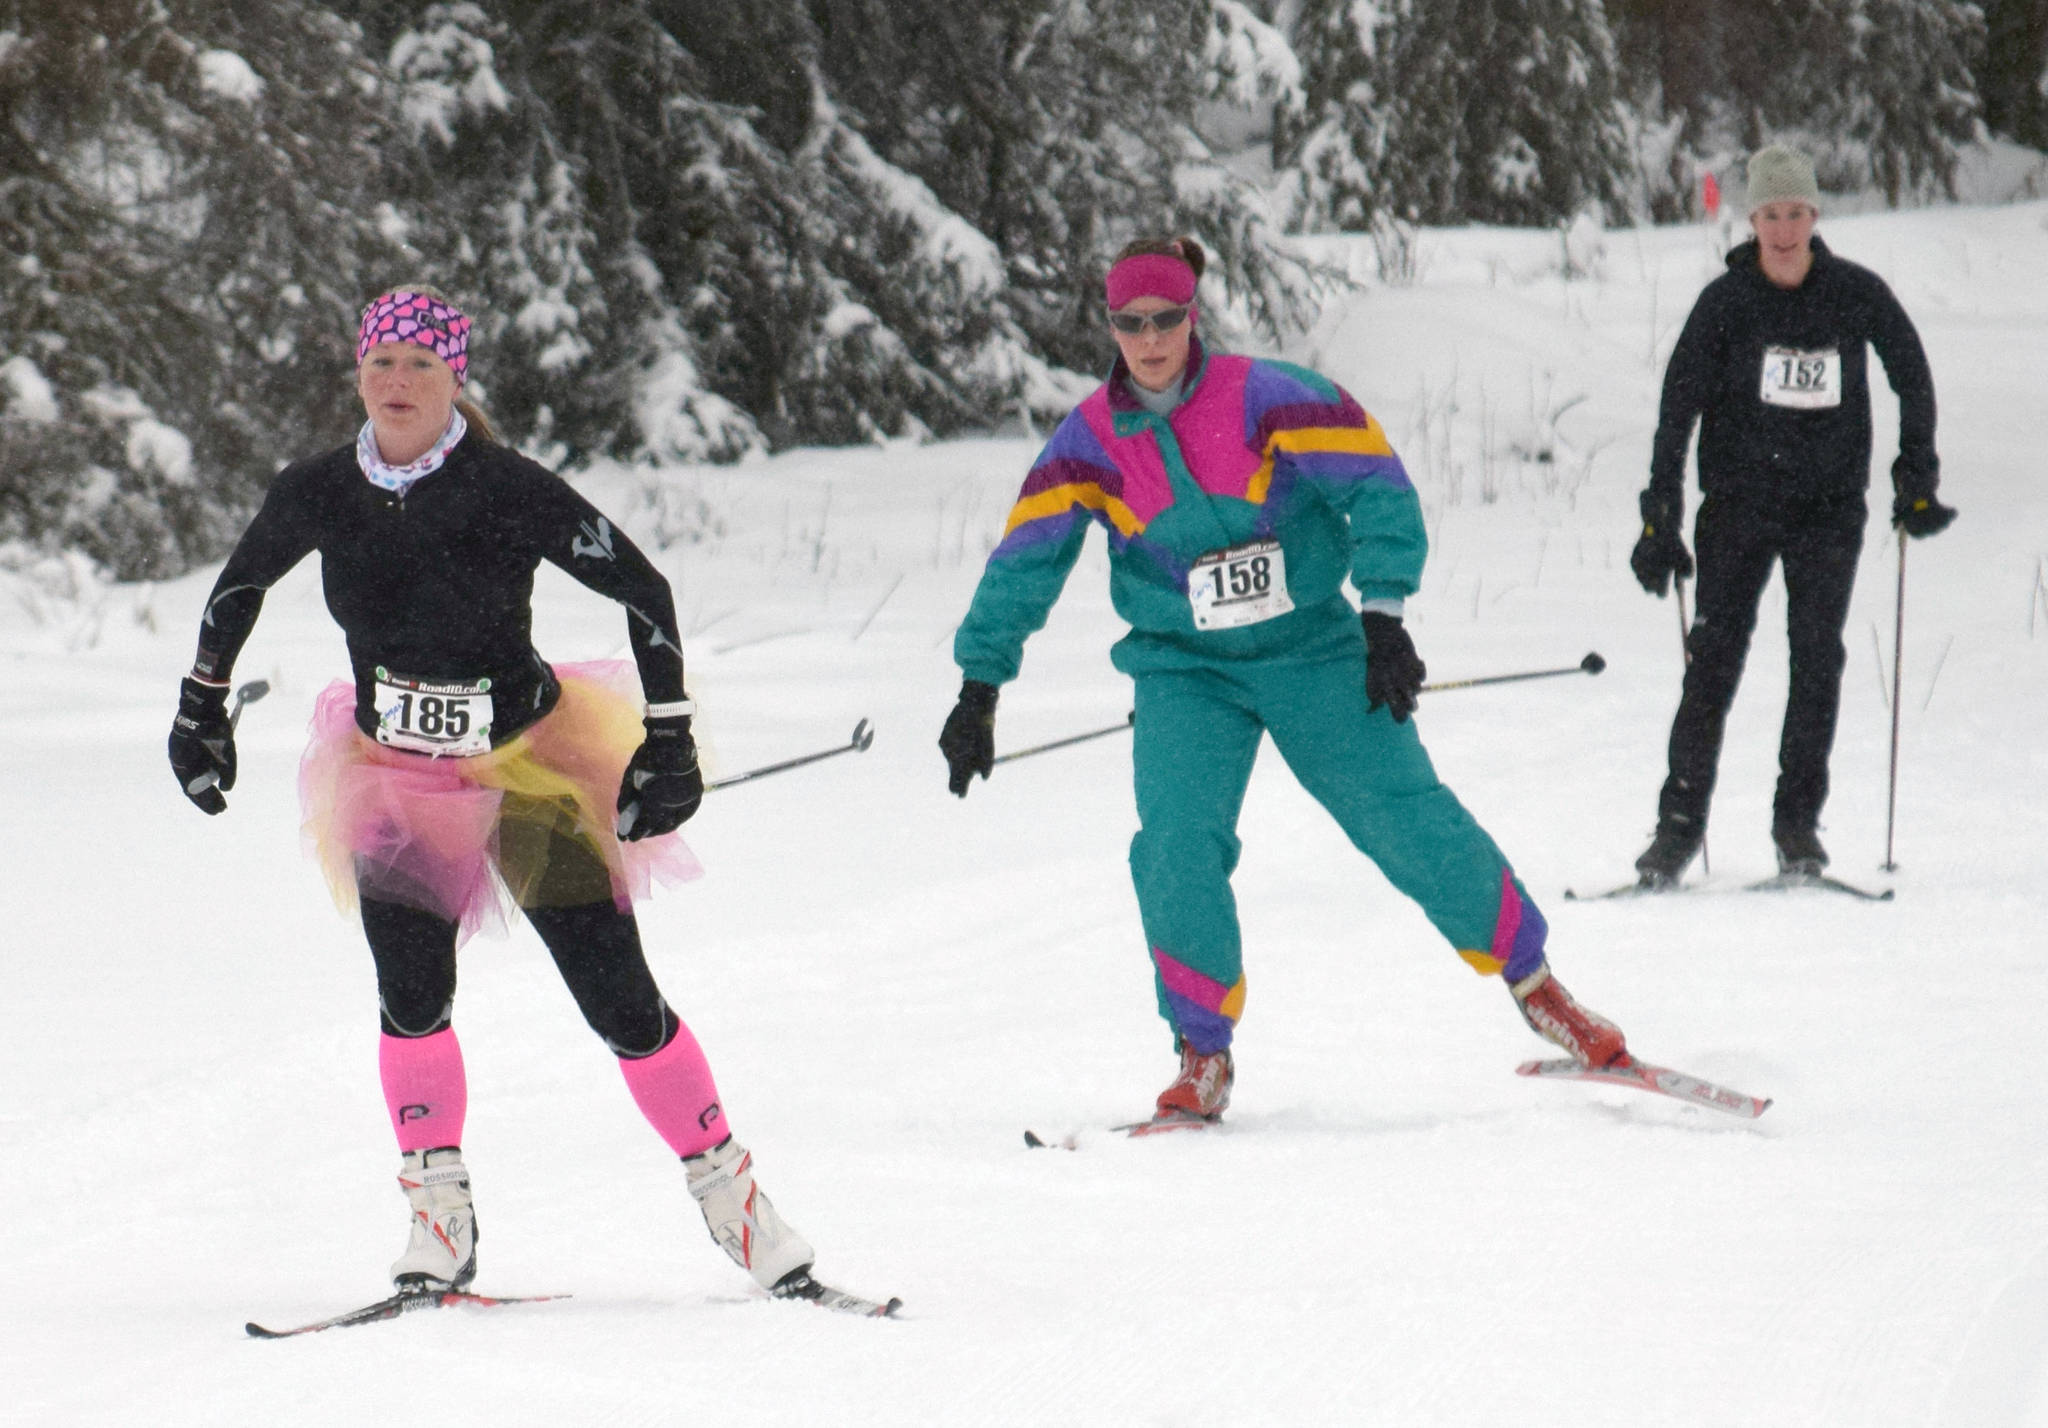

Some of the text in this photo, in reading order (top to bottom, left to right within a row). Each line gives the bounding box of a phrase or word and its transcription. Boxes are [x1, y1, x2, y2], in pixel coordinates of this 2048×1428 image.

[1781, 358, 1827, 388] 152
[1208, 556, 1271, 599] 158
[398, 693, 470, 738] 185
